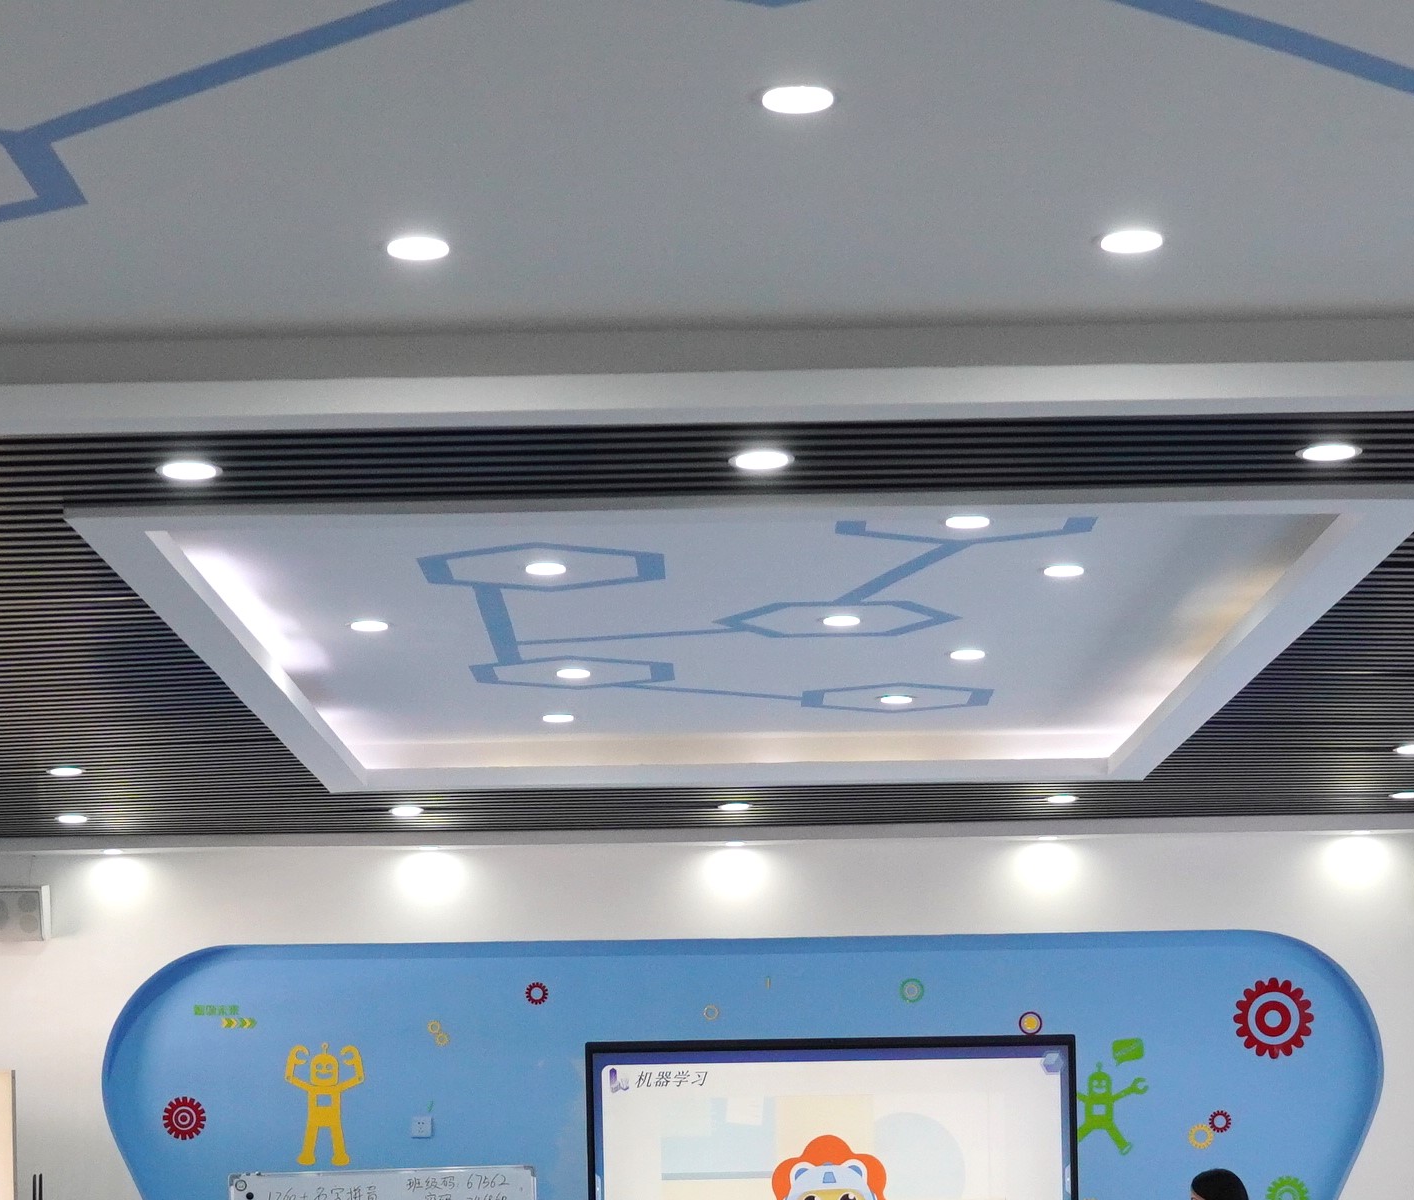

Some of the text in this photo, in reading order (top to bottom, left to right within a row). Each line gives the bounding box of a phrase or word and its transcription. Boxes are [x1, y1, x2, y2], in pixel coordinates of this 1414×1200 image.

[635, 1070, 708, 1089] 机器学习
[466, 1172, 510, 1190] 67562
